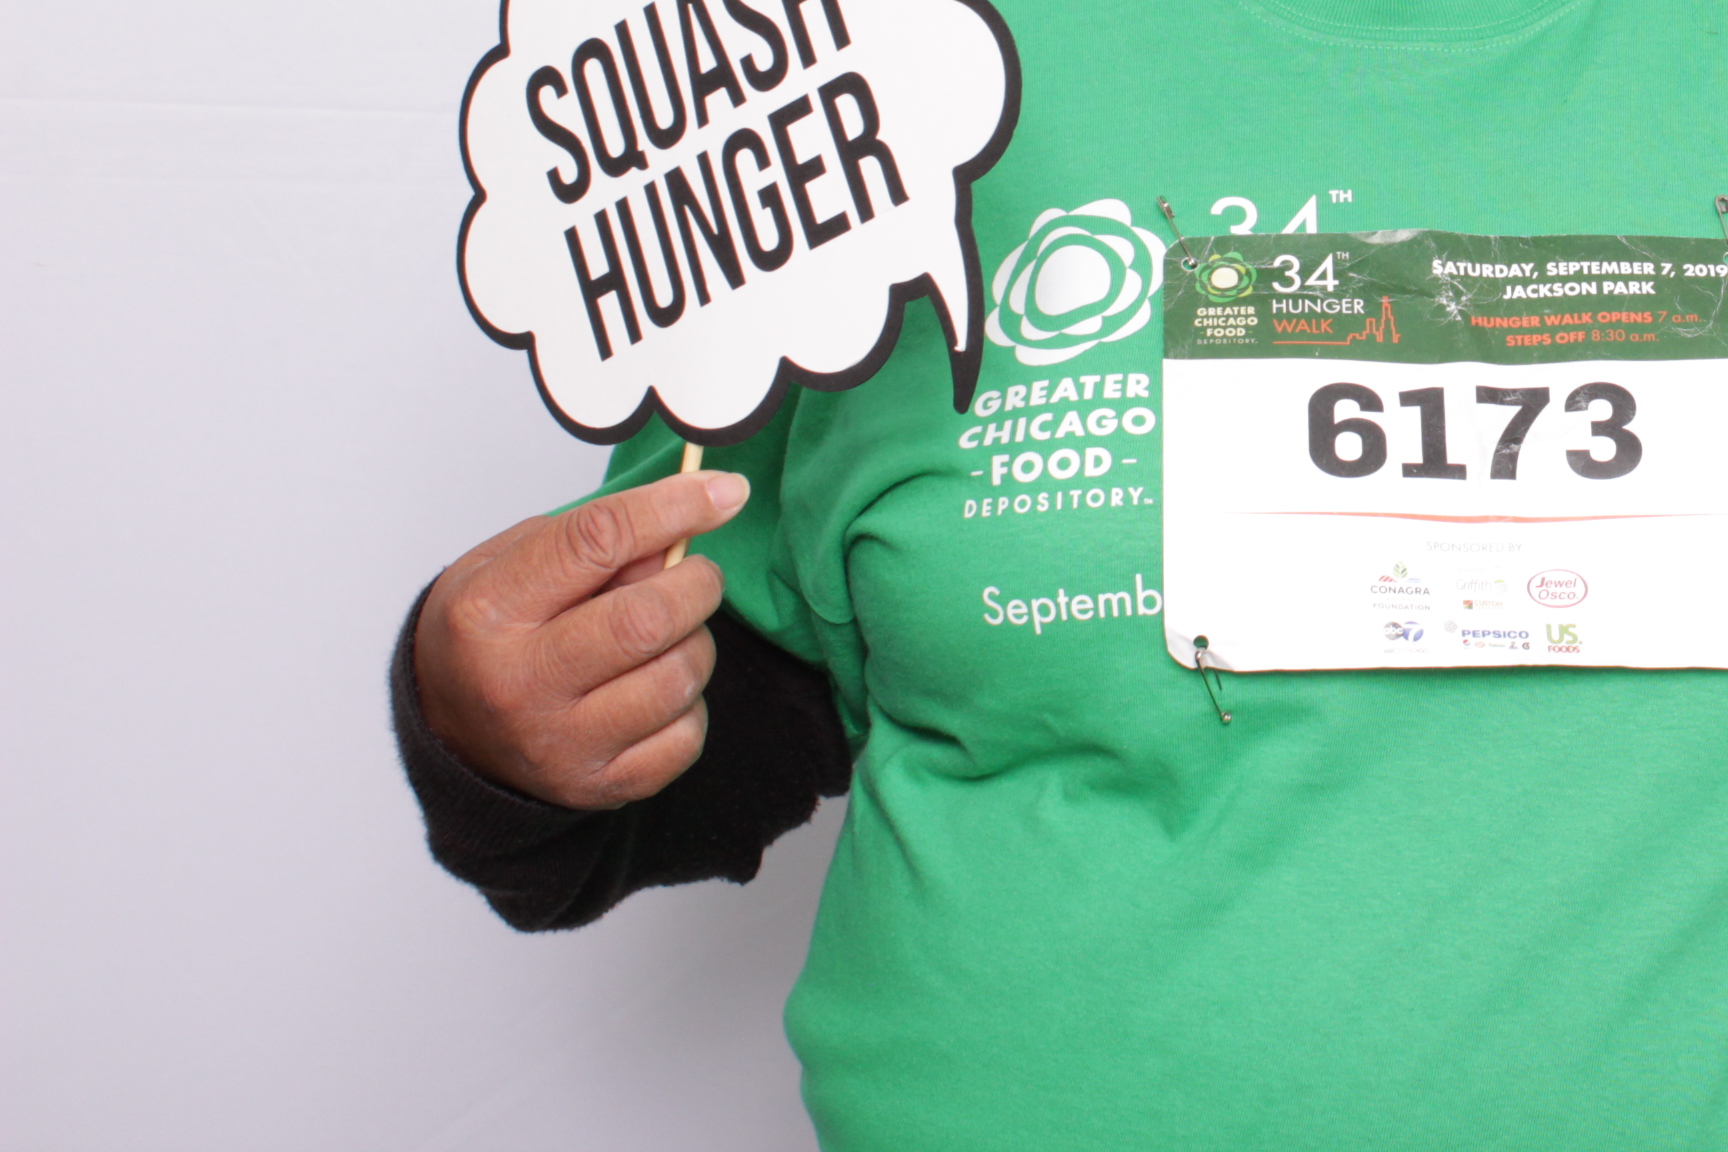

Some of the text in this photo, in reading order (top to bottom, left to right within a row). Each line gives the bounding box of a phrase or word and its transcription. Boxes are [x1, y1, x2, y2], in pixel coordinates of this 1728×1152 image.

[564, 71, 910, 362] HUNGER
[1431, 259, 1728, 279] SATURDAY, SEPTEMBER 7, 2019
[1503, 281, 1656, 300] JACKSON PARK
[1197, 306, 1256, 317] GREATER
[1272, 299, 1365, 314] HUNGER
[1194, 316, 1258, 327] CHICAGO
[1272, 318, 1334, 334] WALK
[1470, 314, 1541, 329] HUNGER
[1544, 312, 1594, 326] WALK
[1596, 311, 1653, 325] OPENS
[1657, 310, 1668, 323] 7
[1506, 333, 1552, 347] STEPS
[1554, 331, 1586, 345] OFF
[1591, 329, 1626, 343] 8:30
[974, 373, 1150, 418] GREATER
[958, 407, 1156, 449] CHICAGO
[1306, 381, 1643, 482] 6173
[963, 486, 1144, 519] DEPOSITORY
[1426, 541, 1504, 553] SPONSORED
[1370, 585, 1431, 596] CONAGRA
[1456, 579, 1492, 594] Griffith
[1535, 577, 1577, 589] Jewel
[982, 573, 1162, 635] Septemb
[1372, 602, 1431, 611] FOUNDATION
[1461, 630, 1529, 639] PEPSICO
[1548, 645, 1581, 653] FOODS
